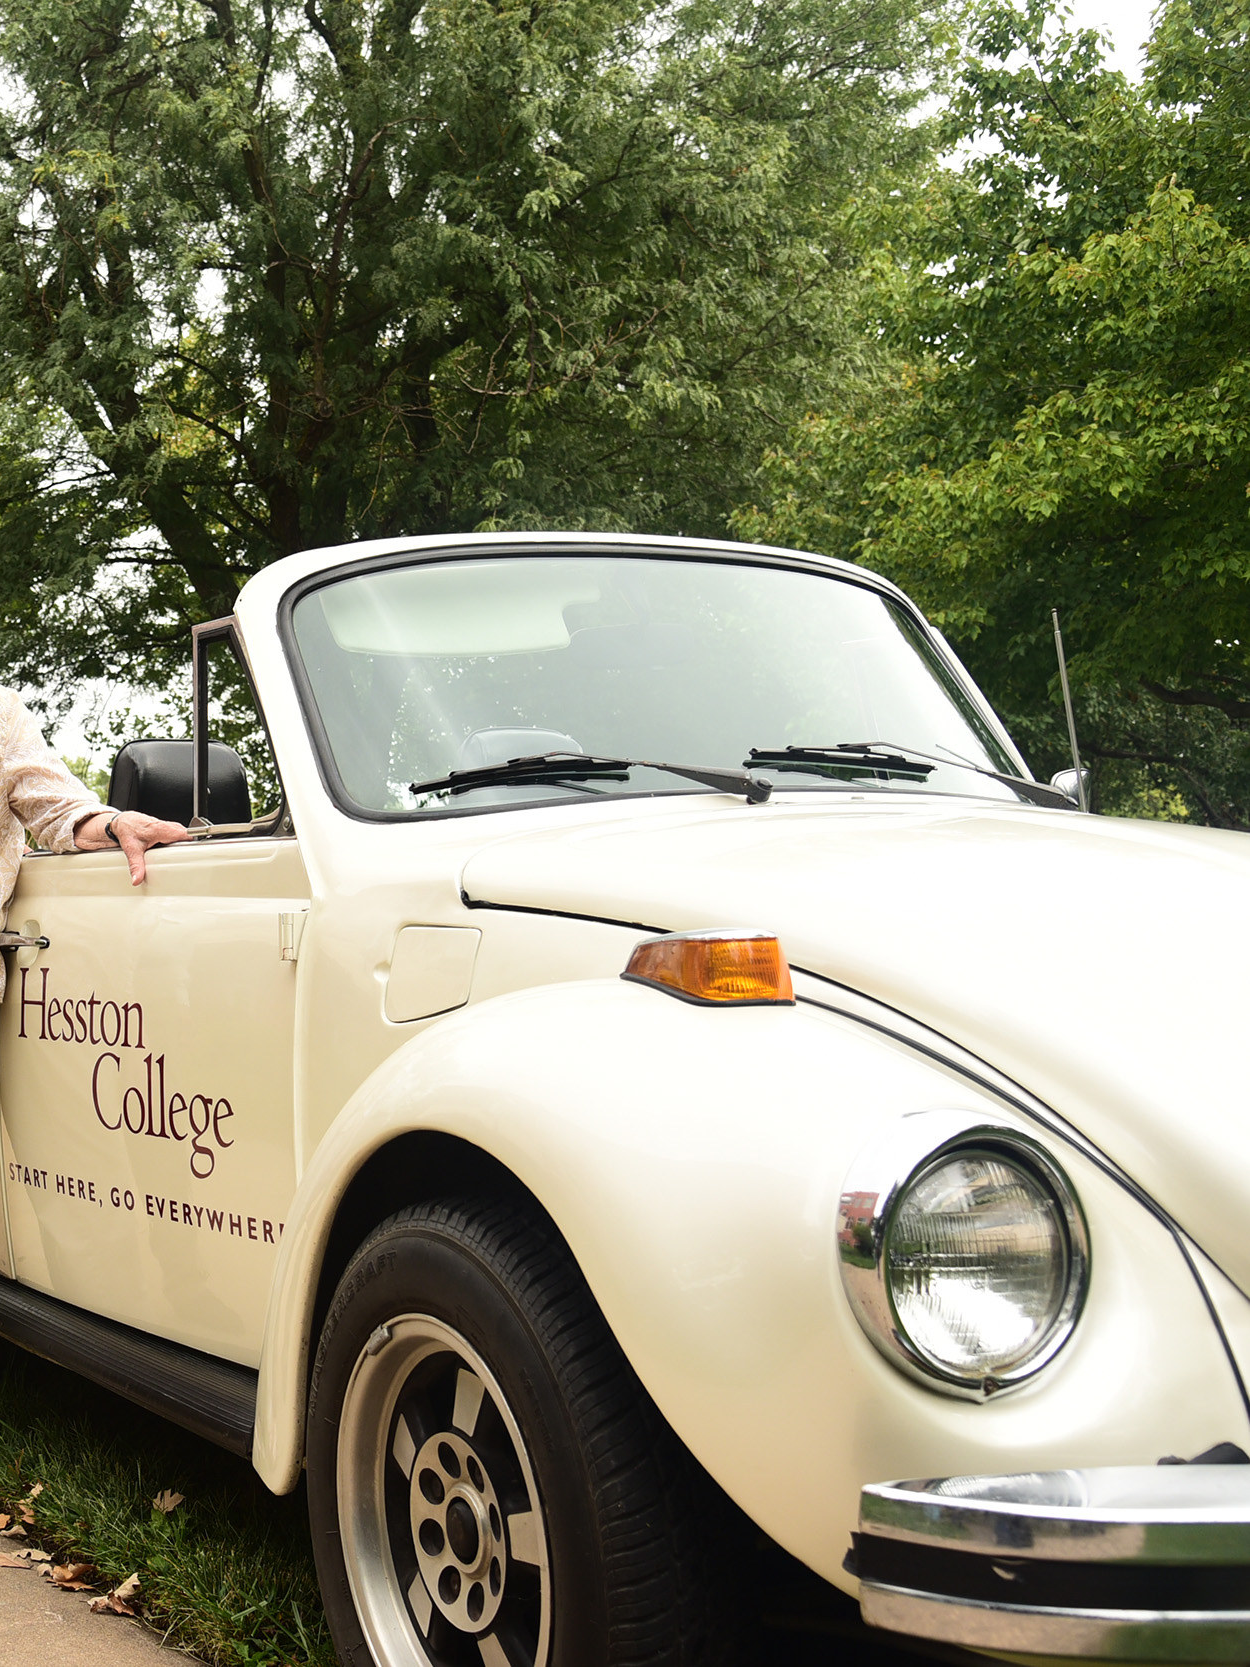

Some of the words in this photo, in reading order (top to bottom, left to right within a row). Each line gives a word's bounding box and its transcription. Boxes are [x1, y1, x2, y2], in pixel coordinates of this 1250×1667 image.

[18, 967, 146, 1049] Hesston
[91, 1052, 234, 1179] College
[9, 1162, 48, 1190] START
[55, 1174, 103, 1208] HERE,
[110, 1187, 135, 1211] GO
